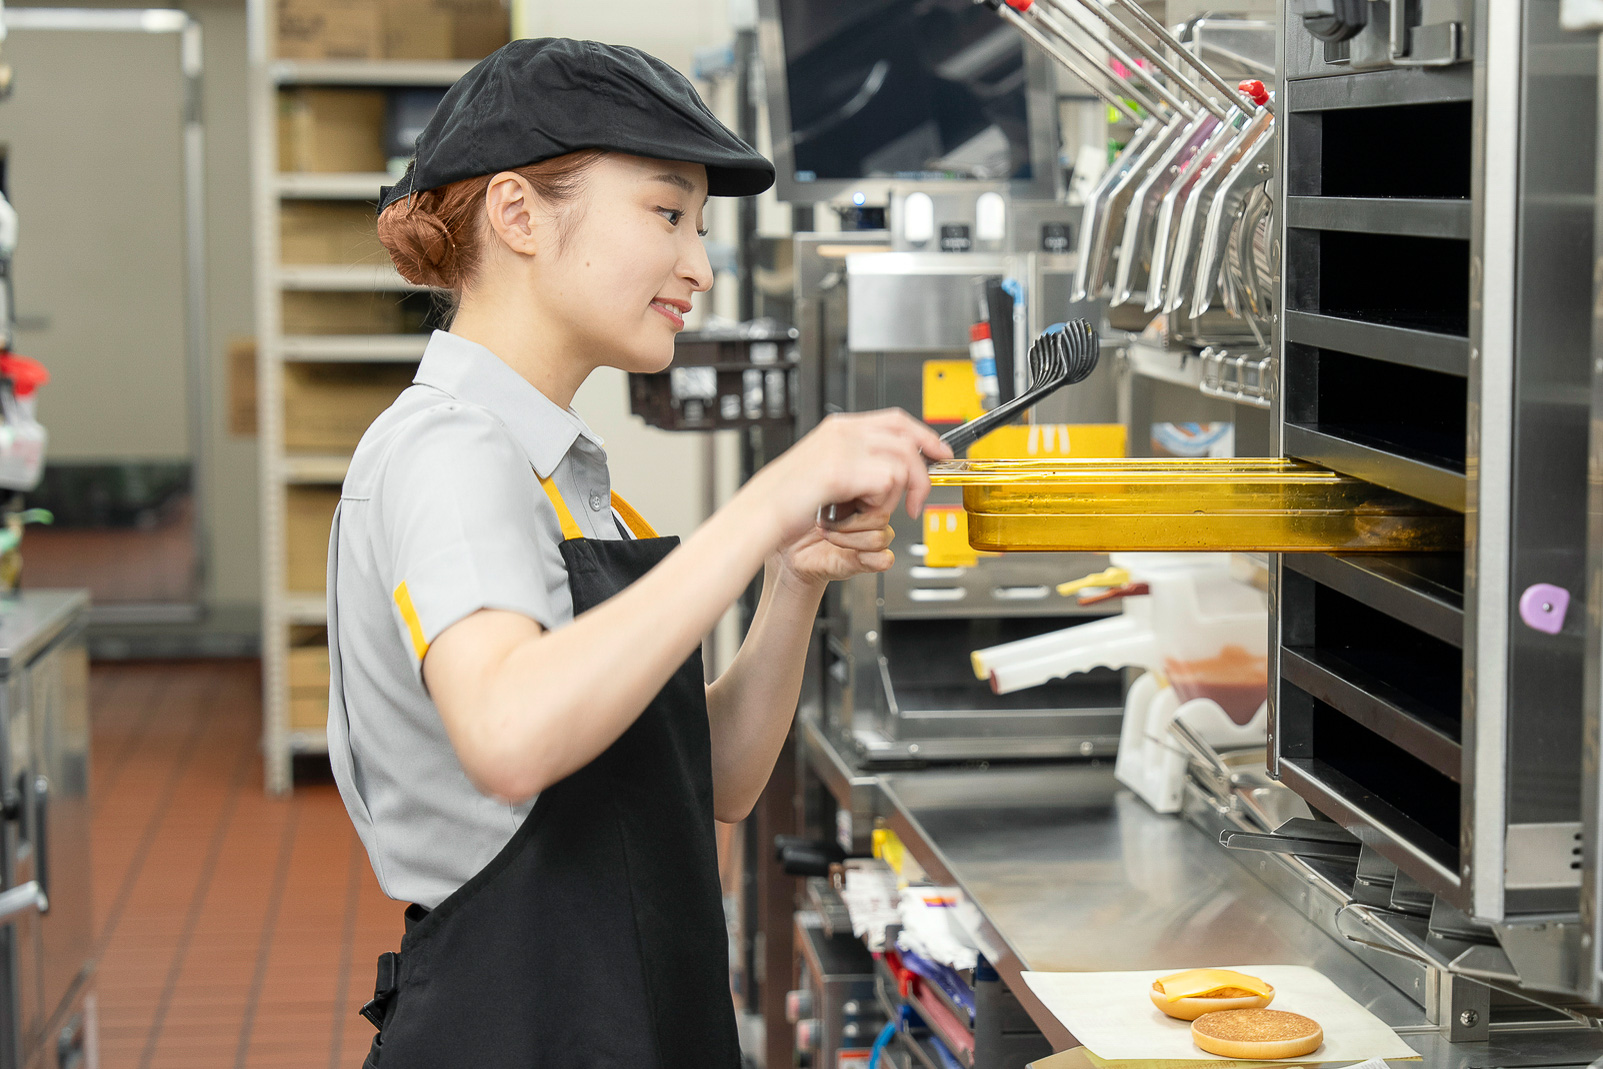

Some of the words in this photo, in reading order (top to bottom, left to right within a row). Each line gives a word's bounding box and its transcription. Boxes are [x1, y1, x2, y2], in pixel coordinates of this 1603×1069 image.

[1272, 239, 1281, 282] 2
[1271, 357, 1279, 400] 3
[1268, 573, 1276, 615] 5
[1267, 683, 1275, 726] 6
